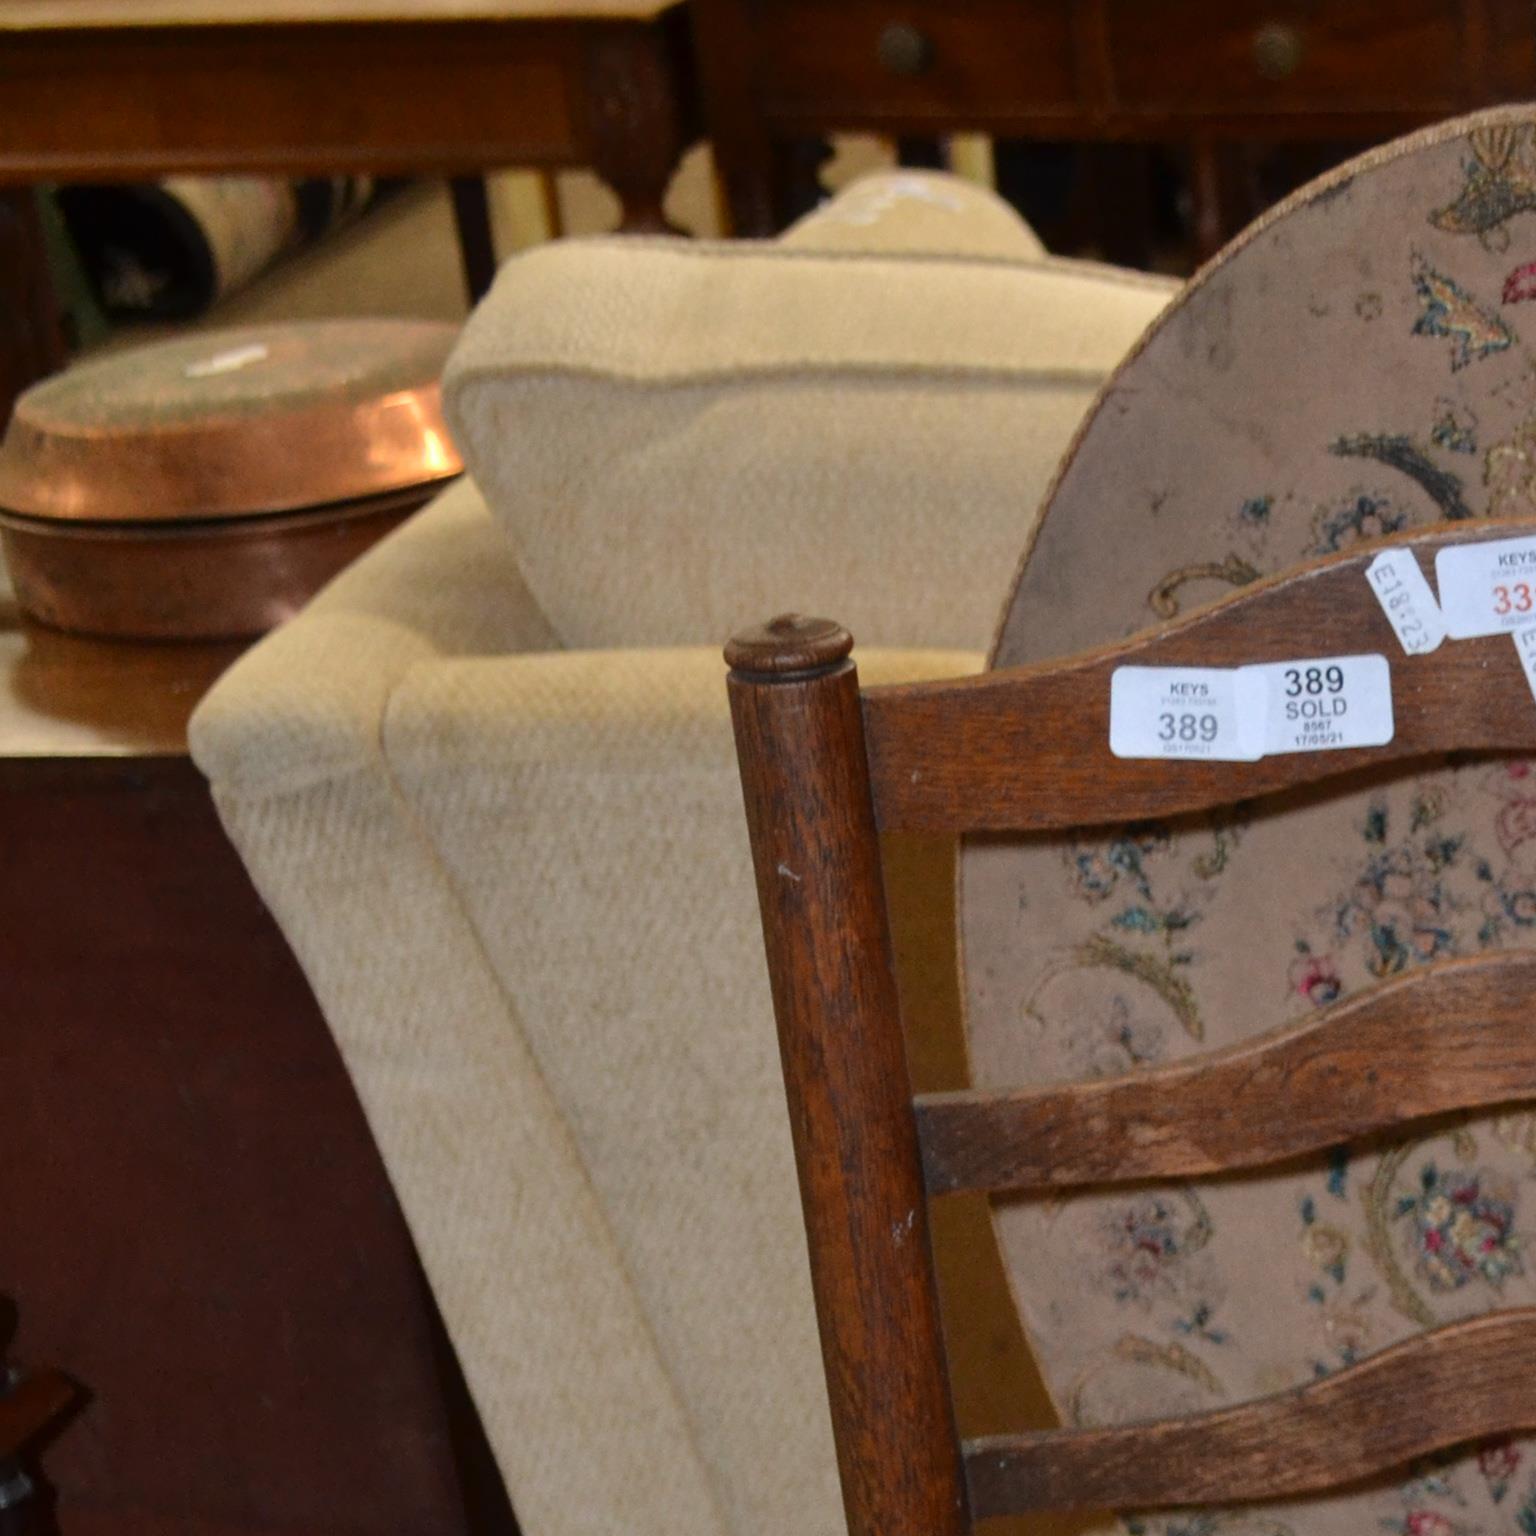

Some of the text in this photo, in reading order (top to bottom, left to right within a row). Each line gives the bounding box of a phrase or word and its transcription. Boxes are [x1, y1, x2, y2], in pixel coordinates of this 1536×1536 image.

[1170, 682, 1209, 696] KEYS
[1284, 665, 1344, 698] 389
[1285, 697, 1347, 720] SOLD
[1158, 713, 1217, 742] 389
